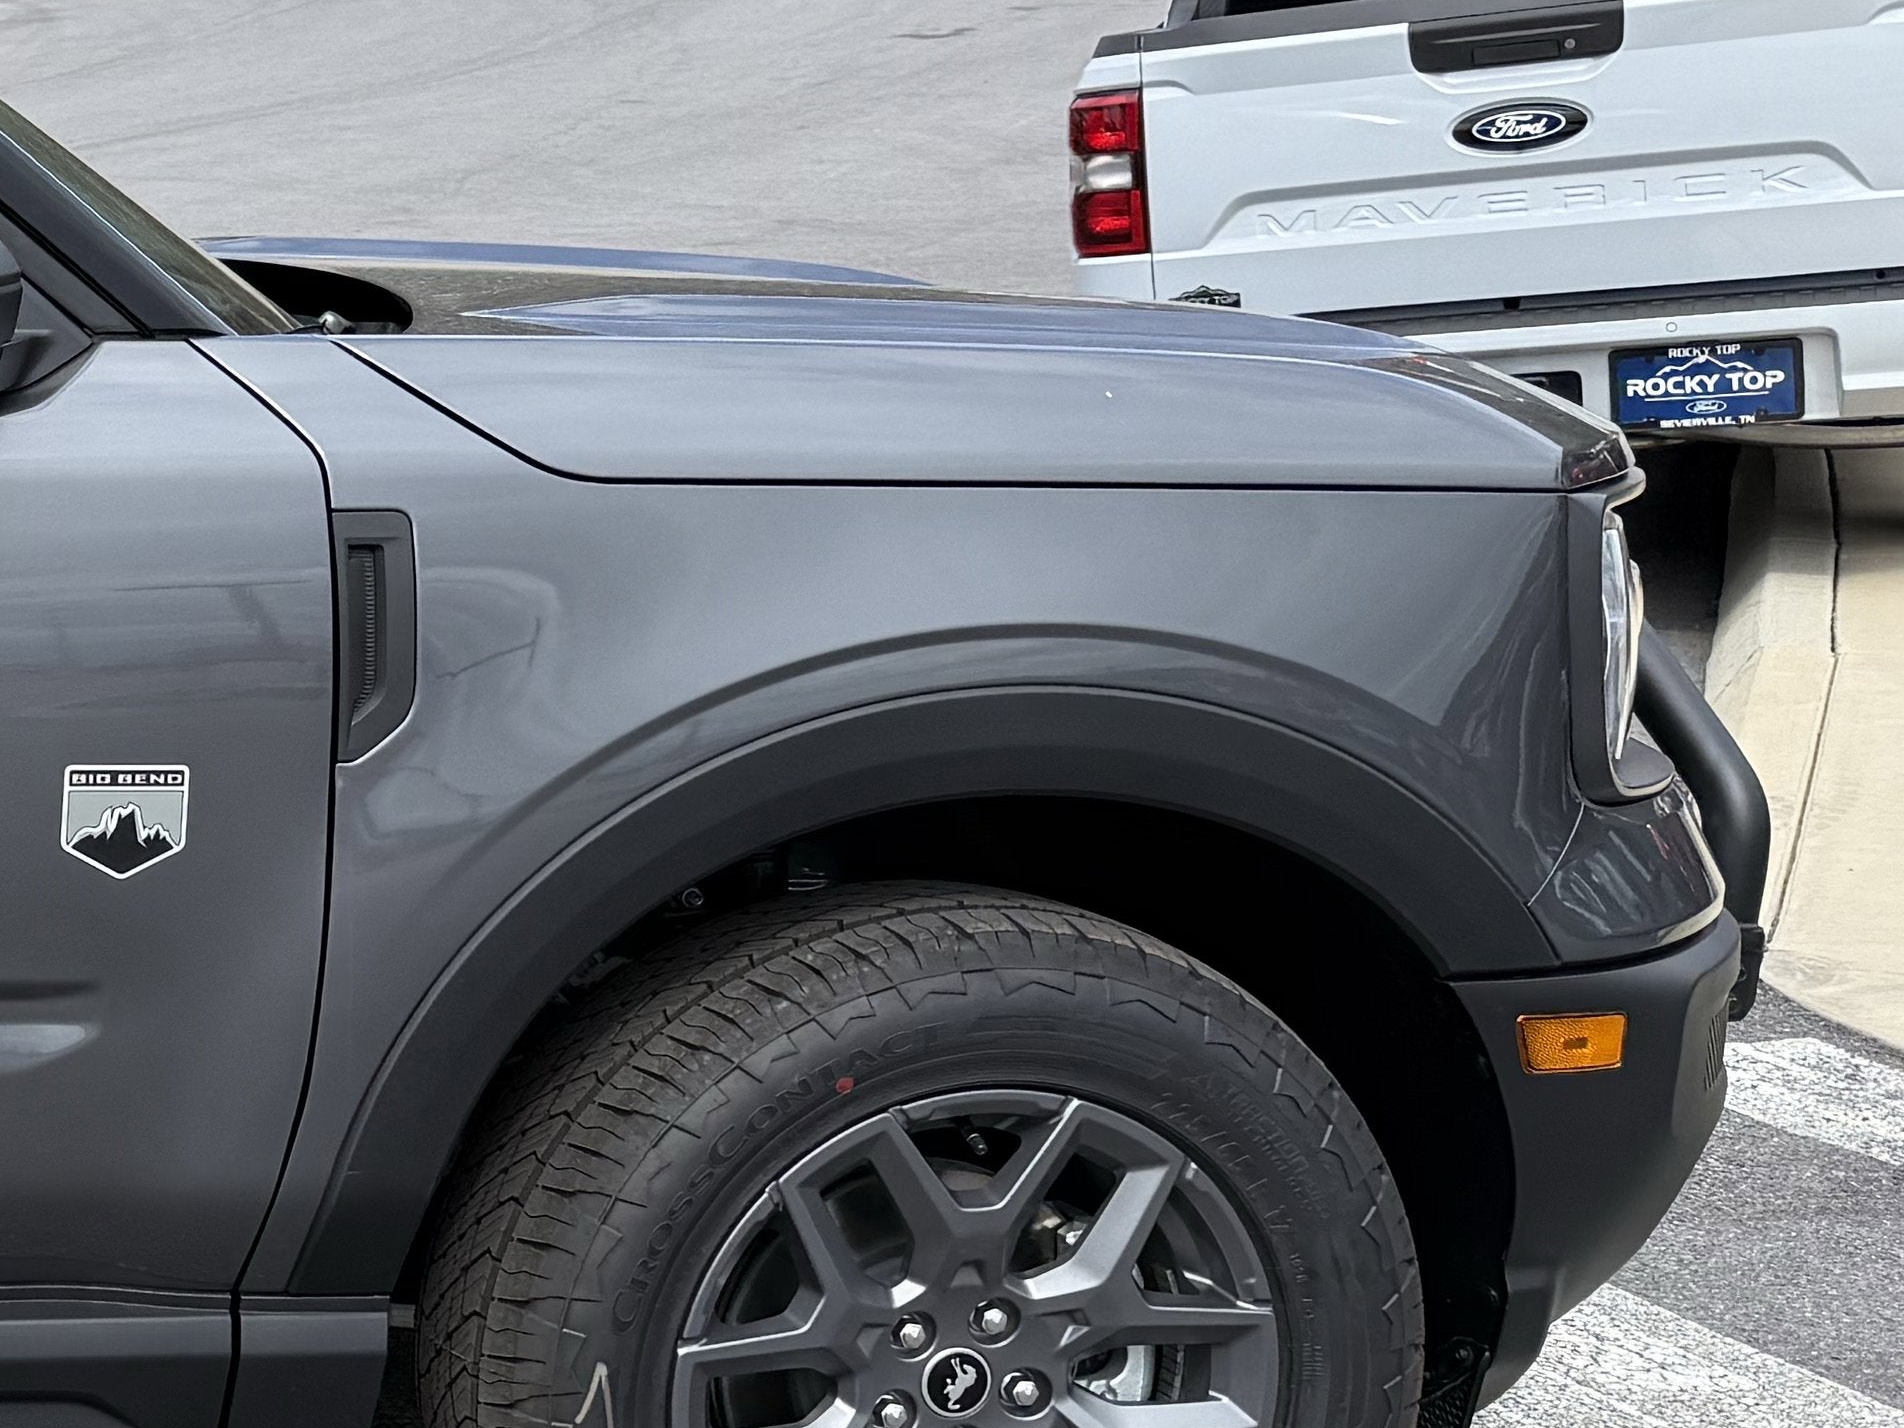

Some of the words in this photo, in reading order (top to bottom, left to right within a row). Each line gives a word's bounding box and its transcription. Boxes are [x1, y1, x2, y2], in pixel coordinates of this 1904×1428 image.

[1490, 113, 1548, 141] Ford
[1254, 164, 1810, 239] MAVERICK
[1668, 345, 1711, 359] ROCKY
[1716, 343, 1742, 356] TOP
[1626, 373, 1720, 397] ROCKY
[1725, 369, 1786, 392] TOP
[71, 772, 111, 785] BIG
[117, 772, 183, 785] BEND
